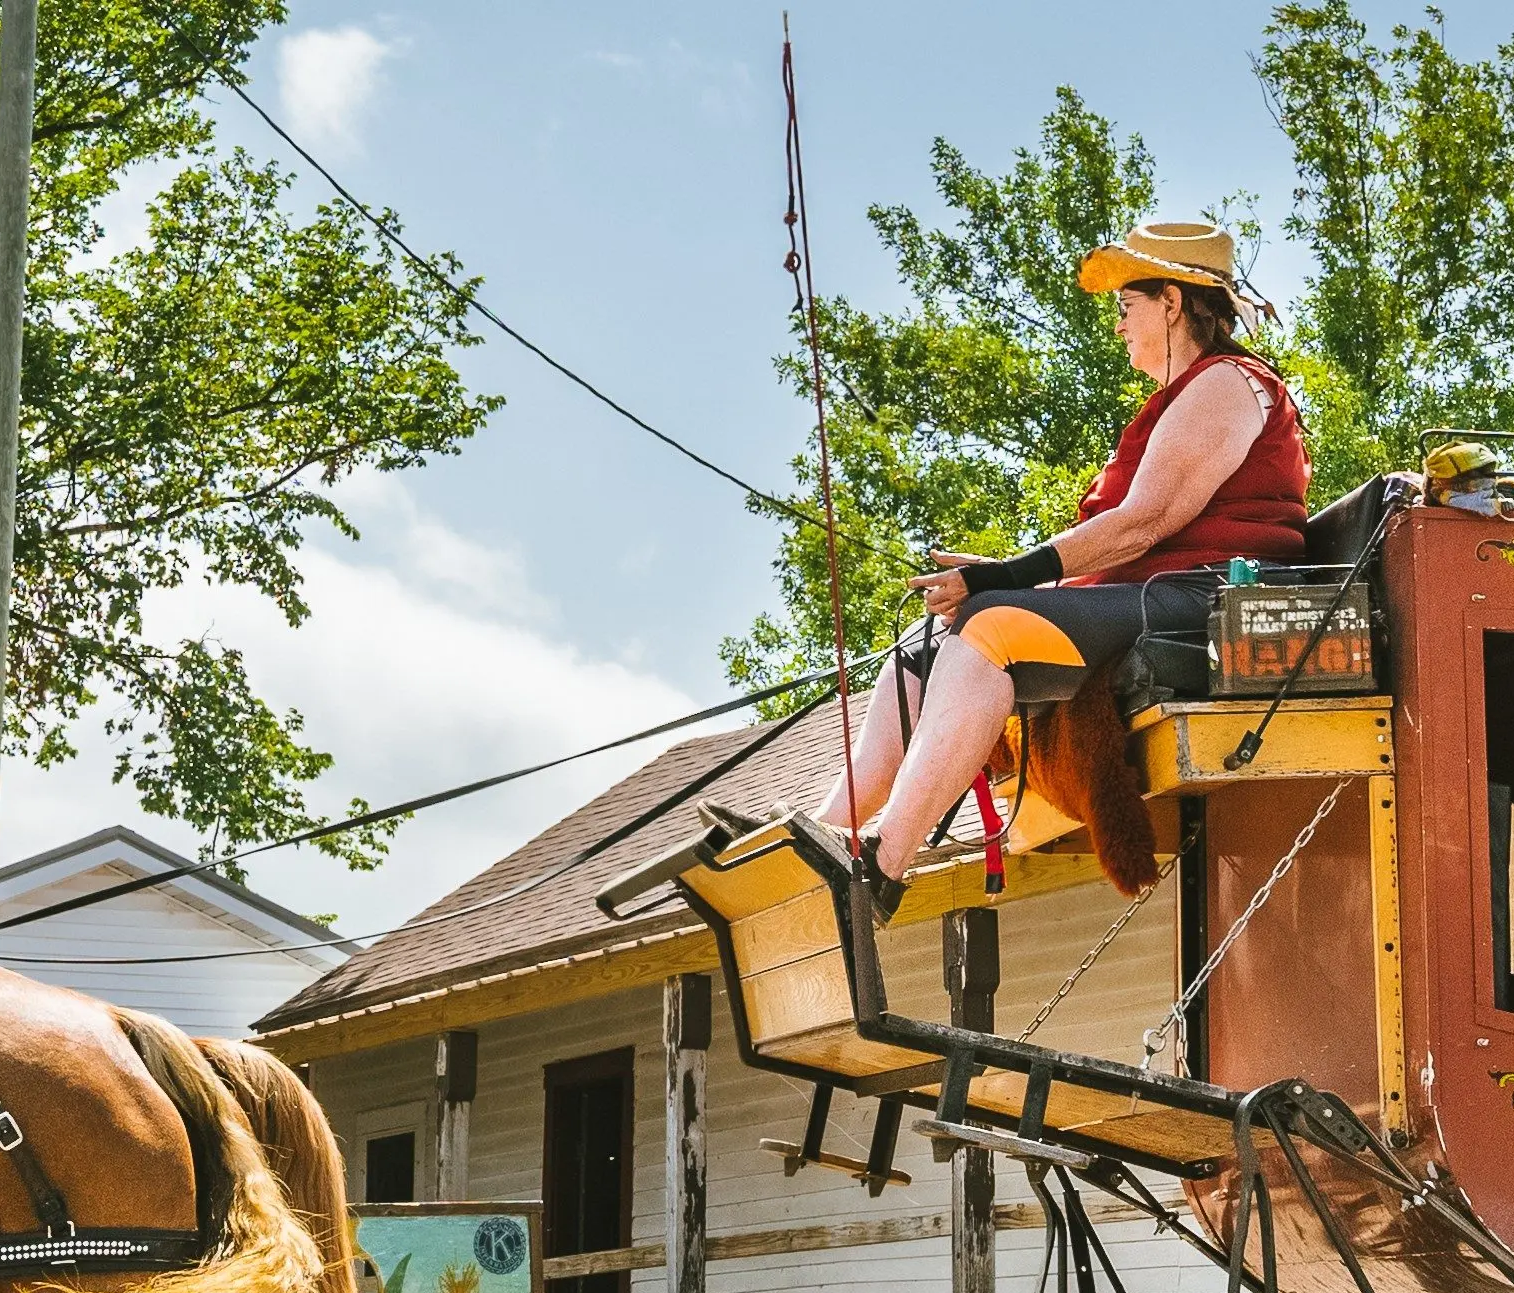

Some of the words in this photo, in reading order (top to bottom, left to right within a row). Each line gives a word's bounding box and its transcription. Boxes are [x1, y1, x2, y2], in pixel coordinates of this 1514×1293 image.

[1241, 600, 1288, 611] RETURN
[1295, 599, 1312, 610] TO
[1281, 607, 1357, 621] INDUSTIES
[1241, 622, 1287, 634] VALLEY
[490, 1230, 512, 1261] K
